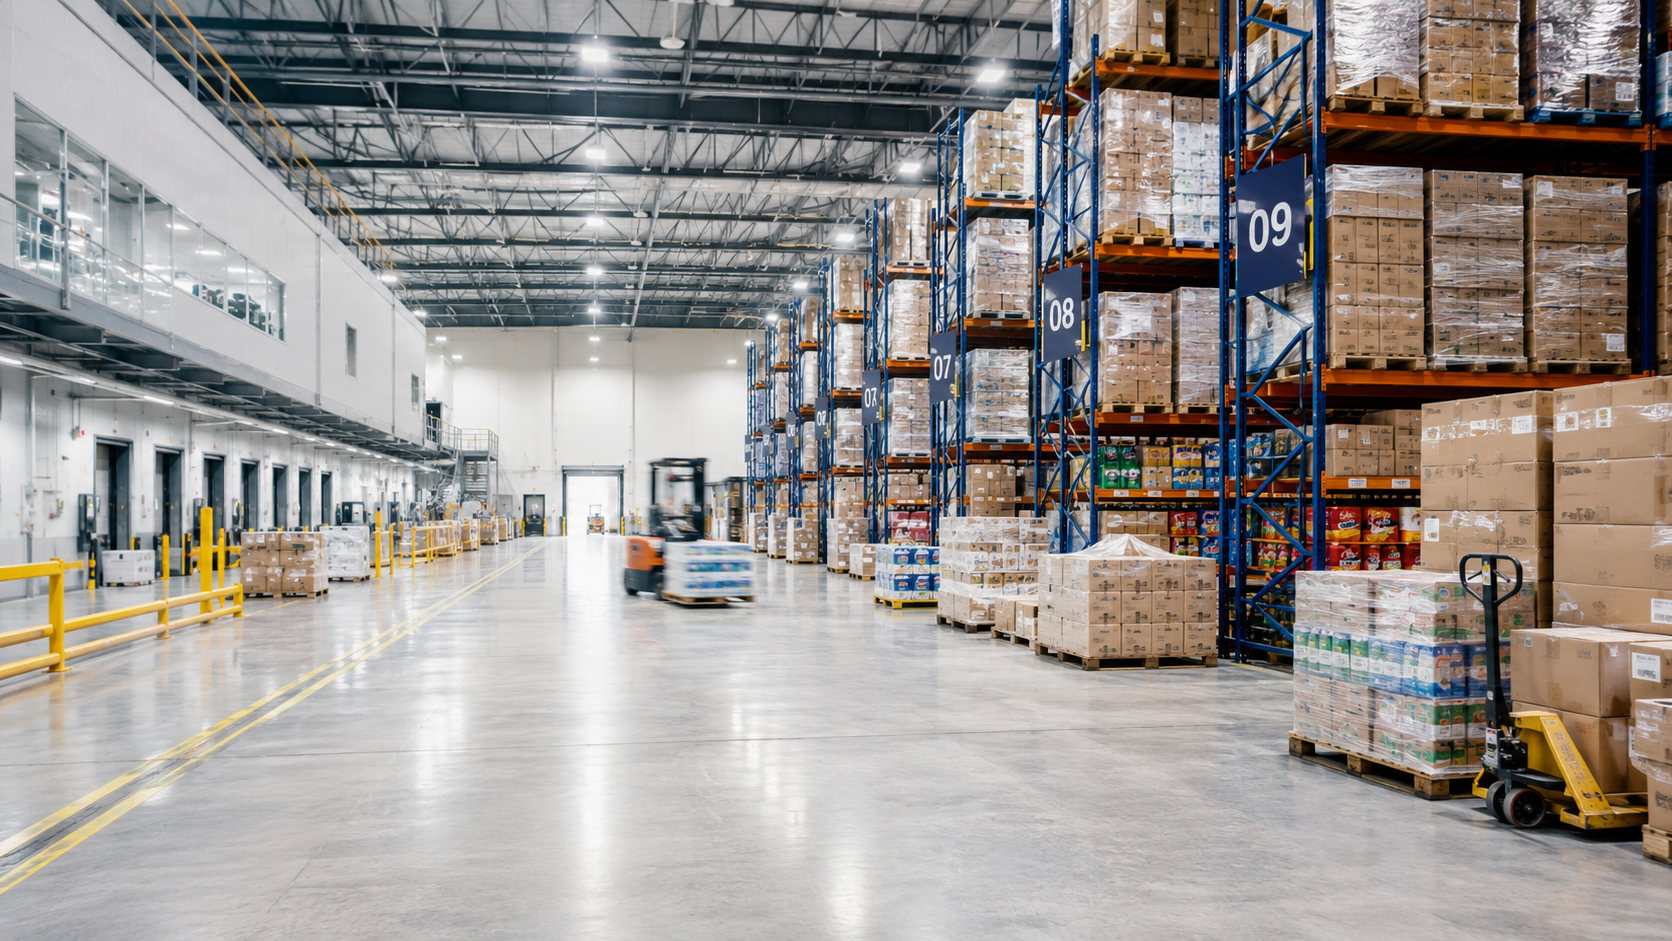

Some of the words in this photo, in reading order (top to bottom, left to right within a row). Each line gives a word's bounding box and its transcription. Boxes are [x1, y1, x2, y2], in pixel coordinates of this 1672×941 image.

[1249, 201, 1292, 253] 09
[1049, 297, 1075, 332] 08
[933, 354, 952, 381] 07
